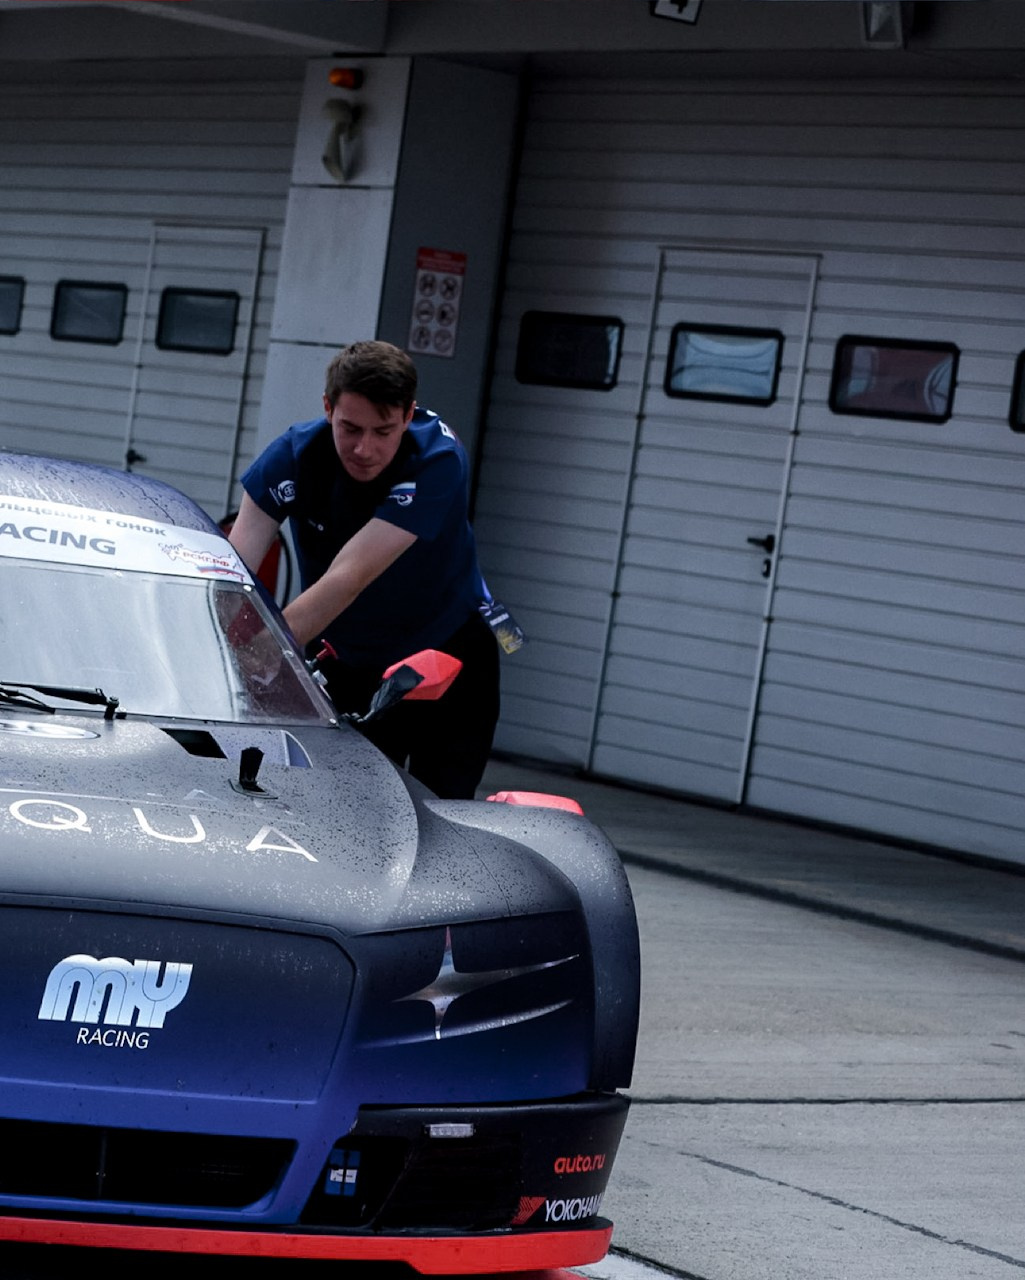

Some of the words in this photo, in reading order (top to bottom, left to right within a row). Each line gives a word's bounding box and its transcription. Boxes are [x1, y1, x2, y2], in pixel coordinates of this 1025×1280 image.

[106, 518, 167, 537] гонок
[76, 1027, 151, 1050] RACING
[554, 1154, 606, 1174] auto.ru
